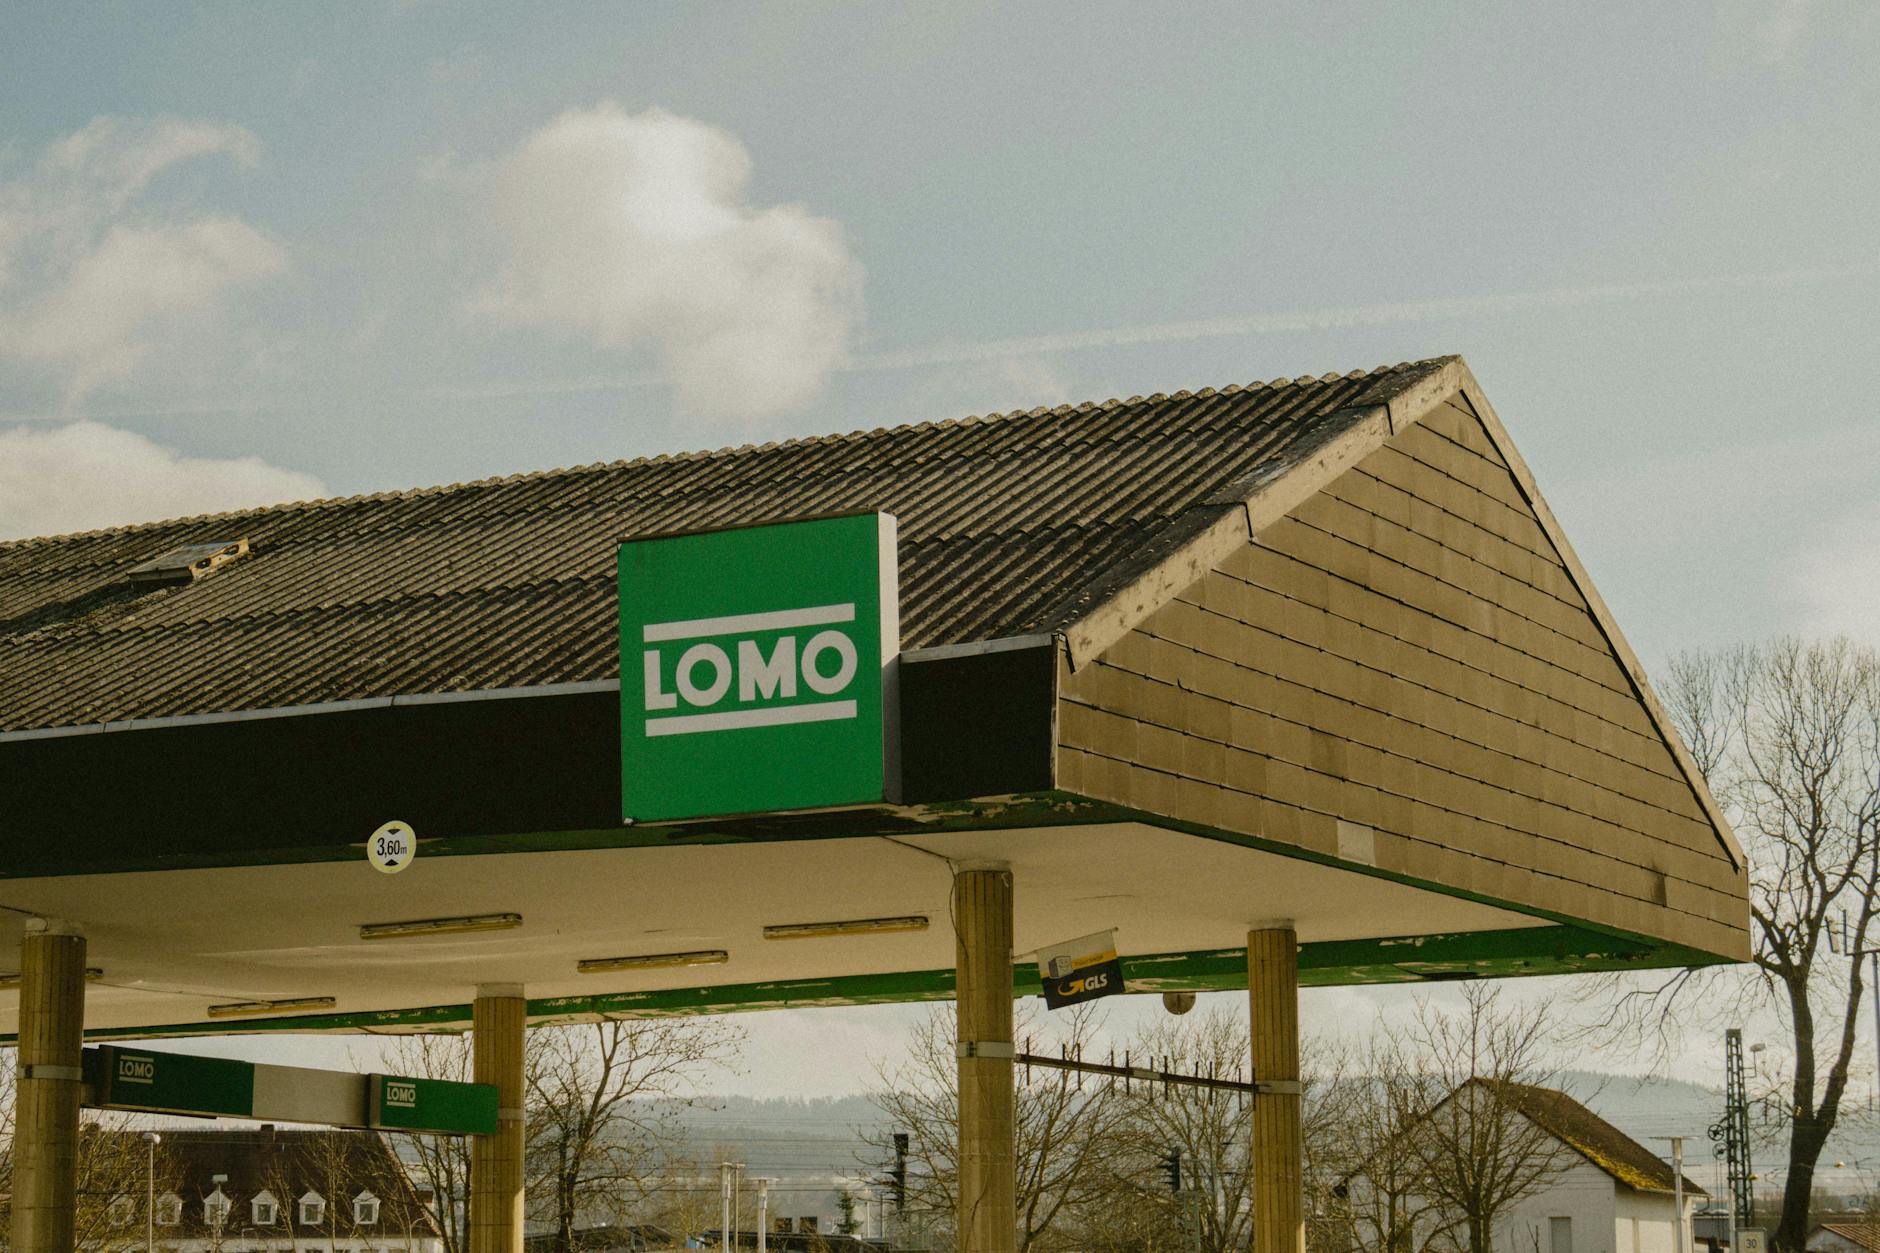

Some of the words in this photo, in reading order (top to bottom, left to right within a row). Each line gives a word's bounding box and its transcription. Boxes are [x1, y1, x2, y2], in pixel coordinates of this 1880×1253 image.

[643, 629, 858, 711] LOMO
[1085, 973, 1108, 990] GLS
[119, 1060, 154, 1078] LOMO
[386, 1087, 416, 1102] LOMO
[1745, 1238, 1757, 1249] 30
